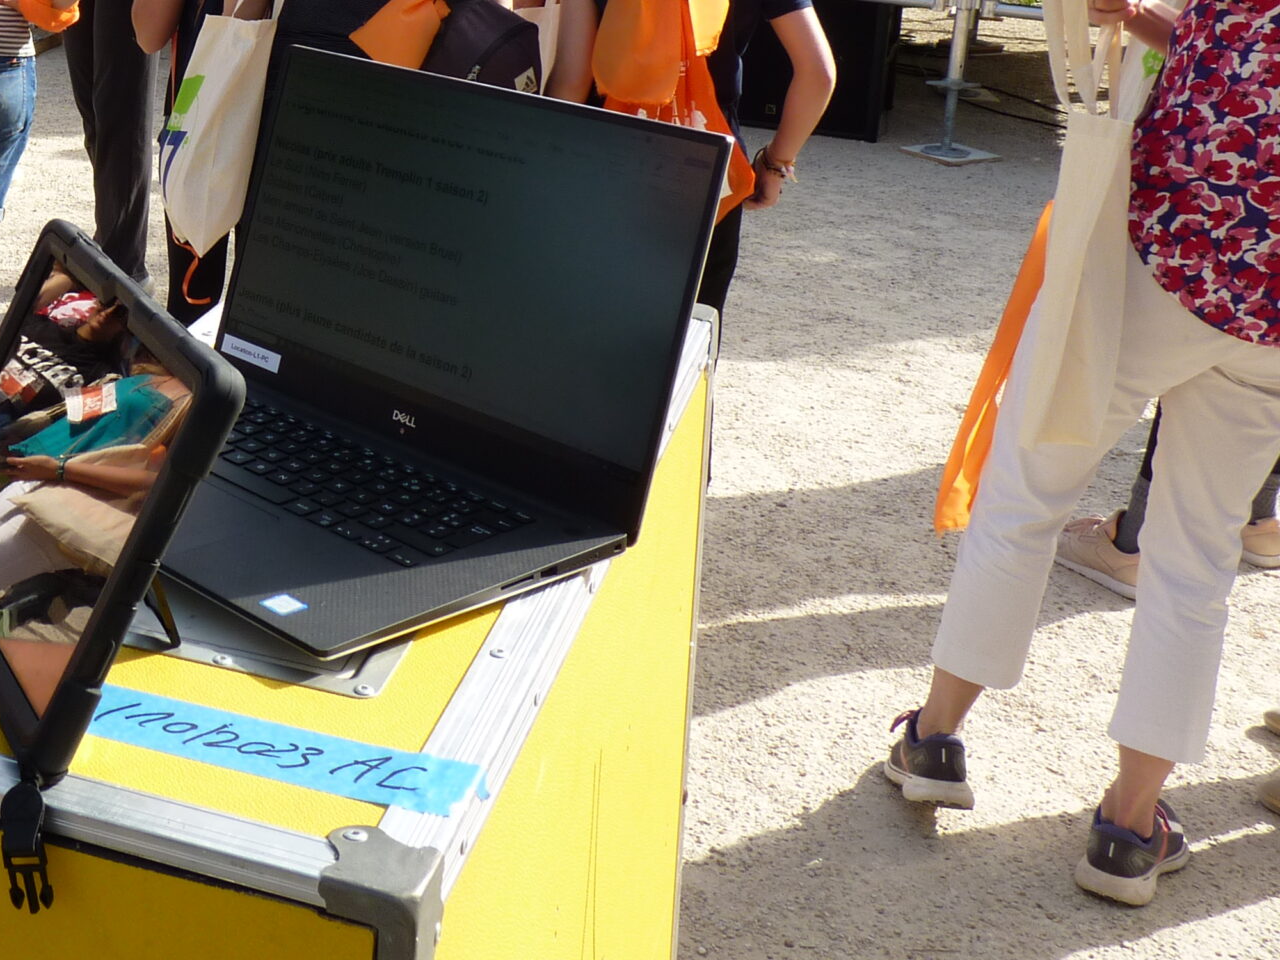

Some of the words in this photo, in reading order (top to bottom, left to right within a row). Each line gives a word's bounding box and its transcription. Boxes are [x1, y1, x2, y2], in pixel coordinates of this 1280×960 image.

[376, 161, 423, 186] Tremplin
[435, 181, 474, 199] saison
[477, 190, 489, 207] 2)
[335, 322, 387, 349] candidate
[390, 340, 404, 355] de
[418, 352, 458, 375] saison
[461, 364, 473, 383] 2)
[392, 410, 416, 428] DELL
